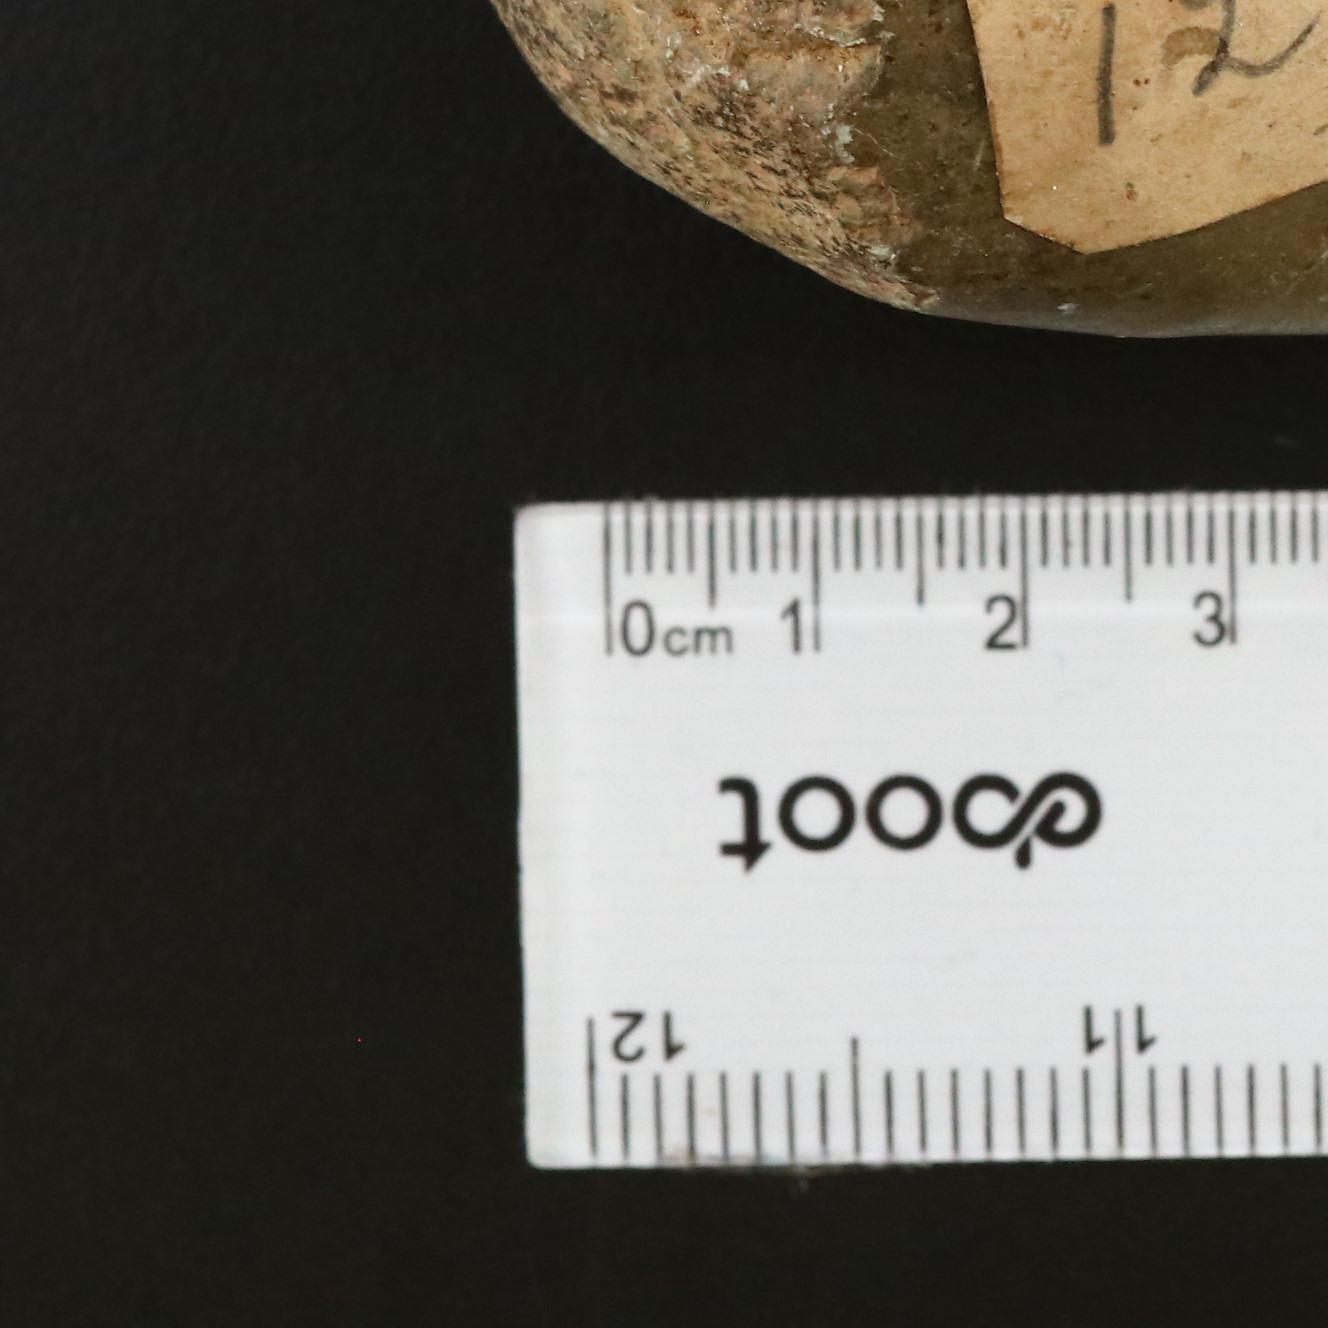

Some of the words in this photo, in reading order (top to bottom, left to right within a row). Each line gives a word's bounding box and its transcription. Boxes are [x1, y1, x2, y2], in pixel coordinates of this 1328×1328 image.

[780, 598, 802, 655] 1
[985, 595, 1018, 651] 2
[1193, 591, 1226, 647] 3
[611, 1010, 687, 1062] 12
[1083, 1004, 1156, 1056] 11
